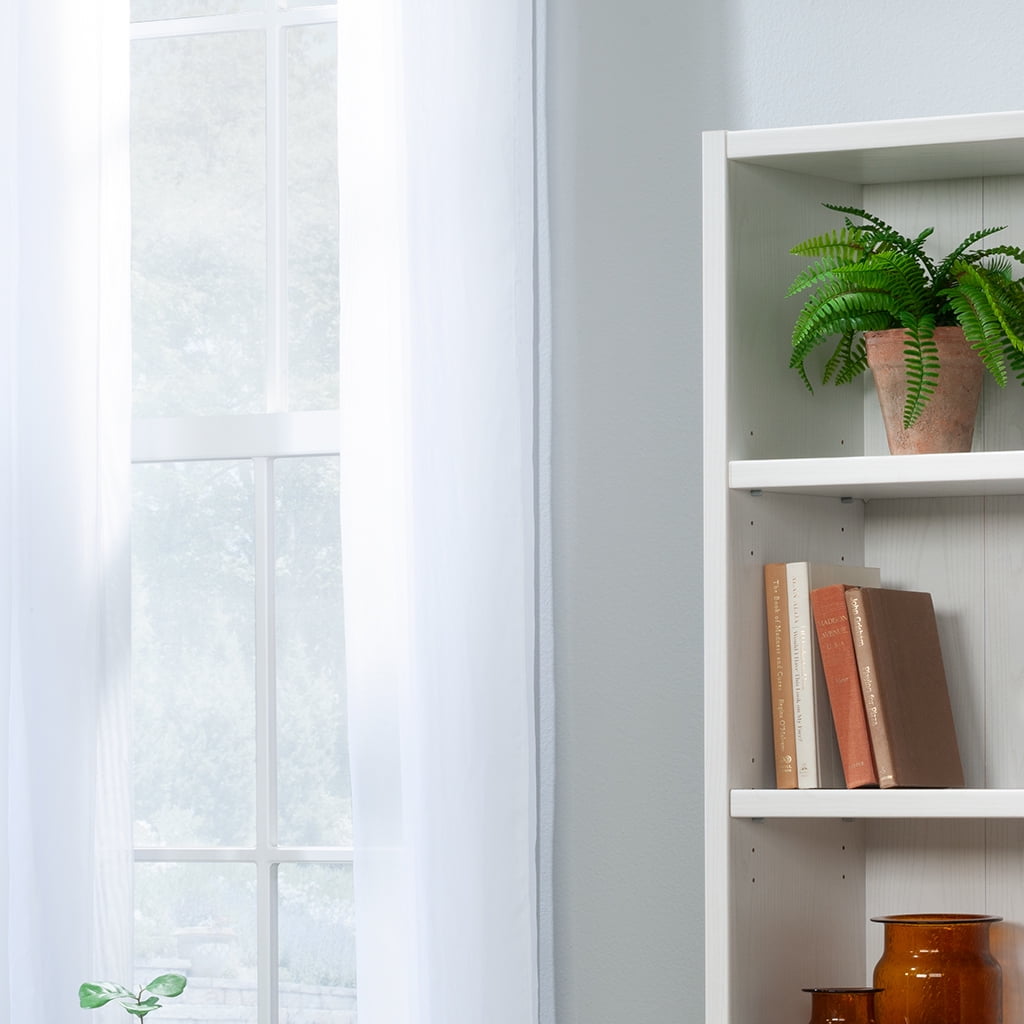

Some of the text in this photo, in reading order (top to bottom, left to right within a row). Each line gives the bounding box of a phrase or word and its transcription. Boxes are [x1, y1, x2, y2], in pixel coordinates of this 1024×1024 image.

[772, 579, 780, 593] The
[851, 598, 860, 615] John
[775, 615, 781, 625] of
